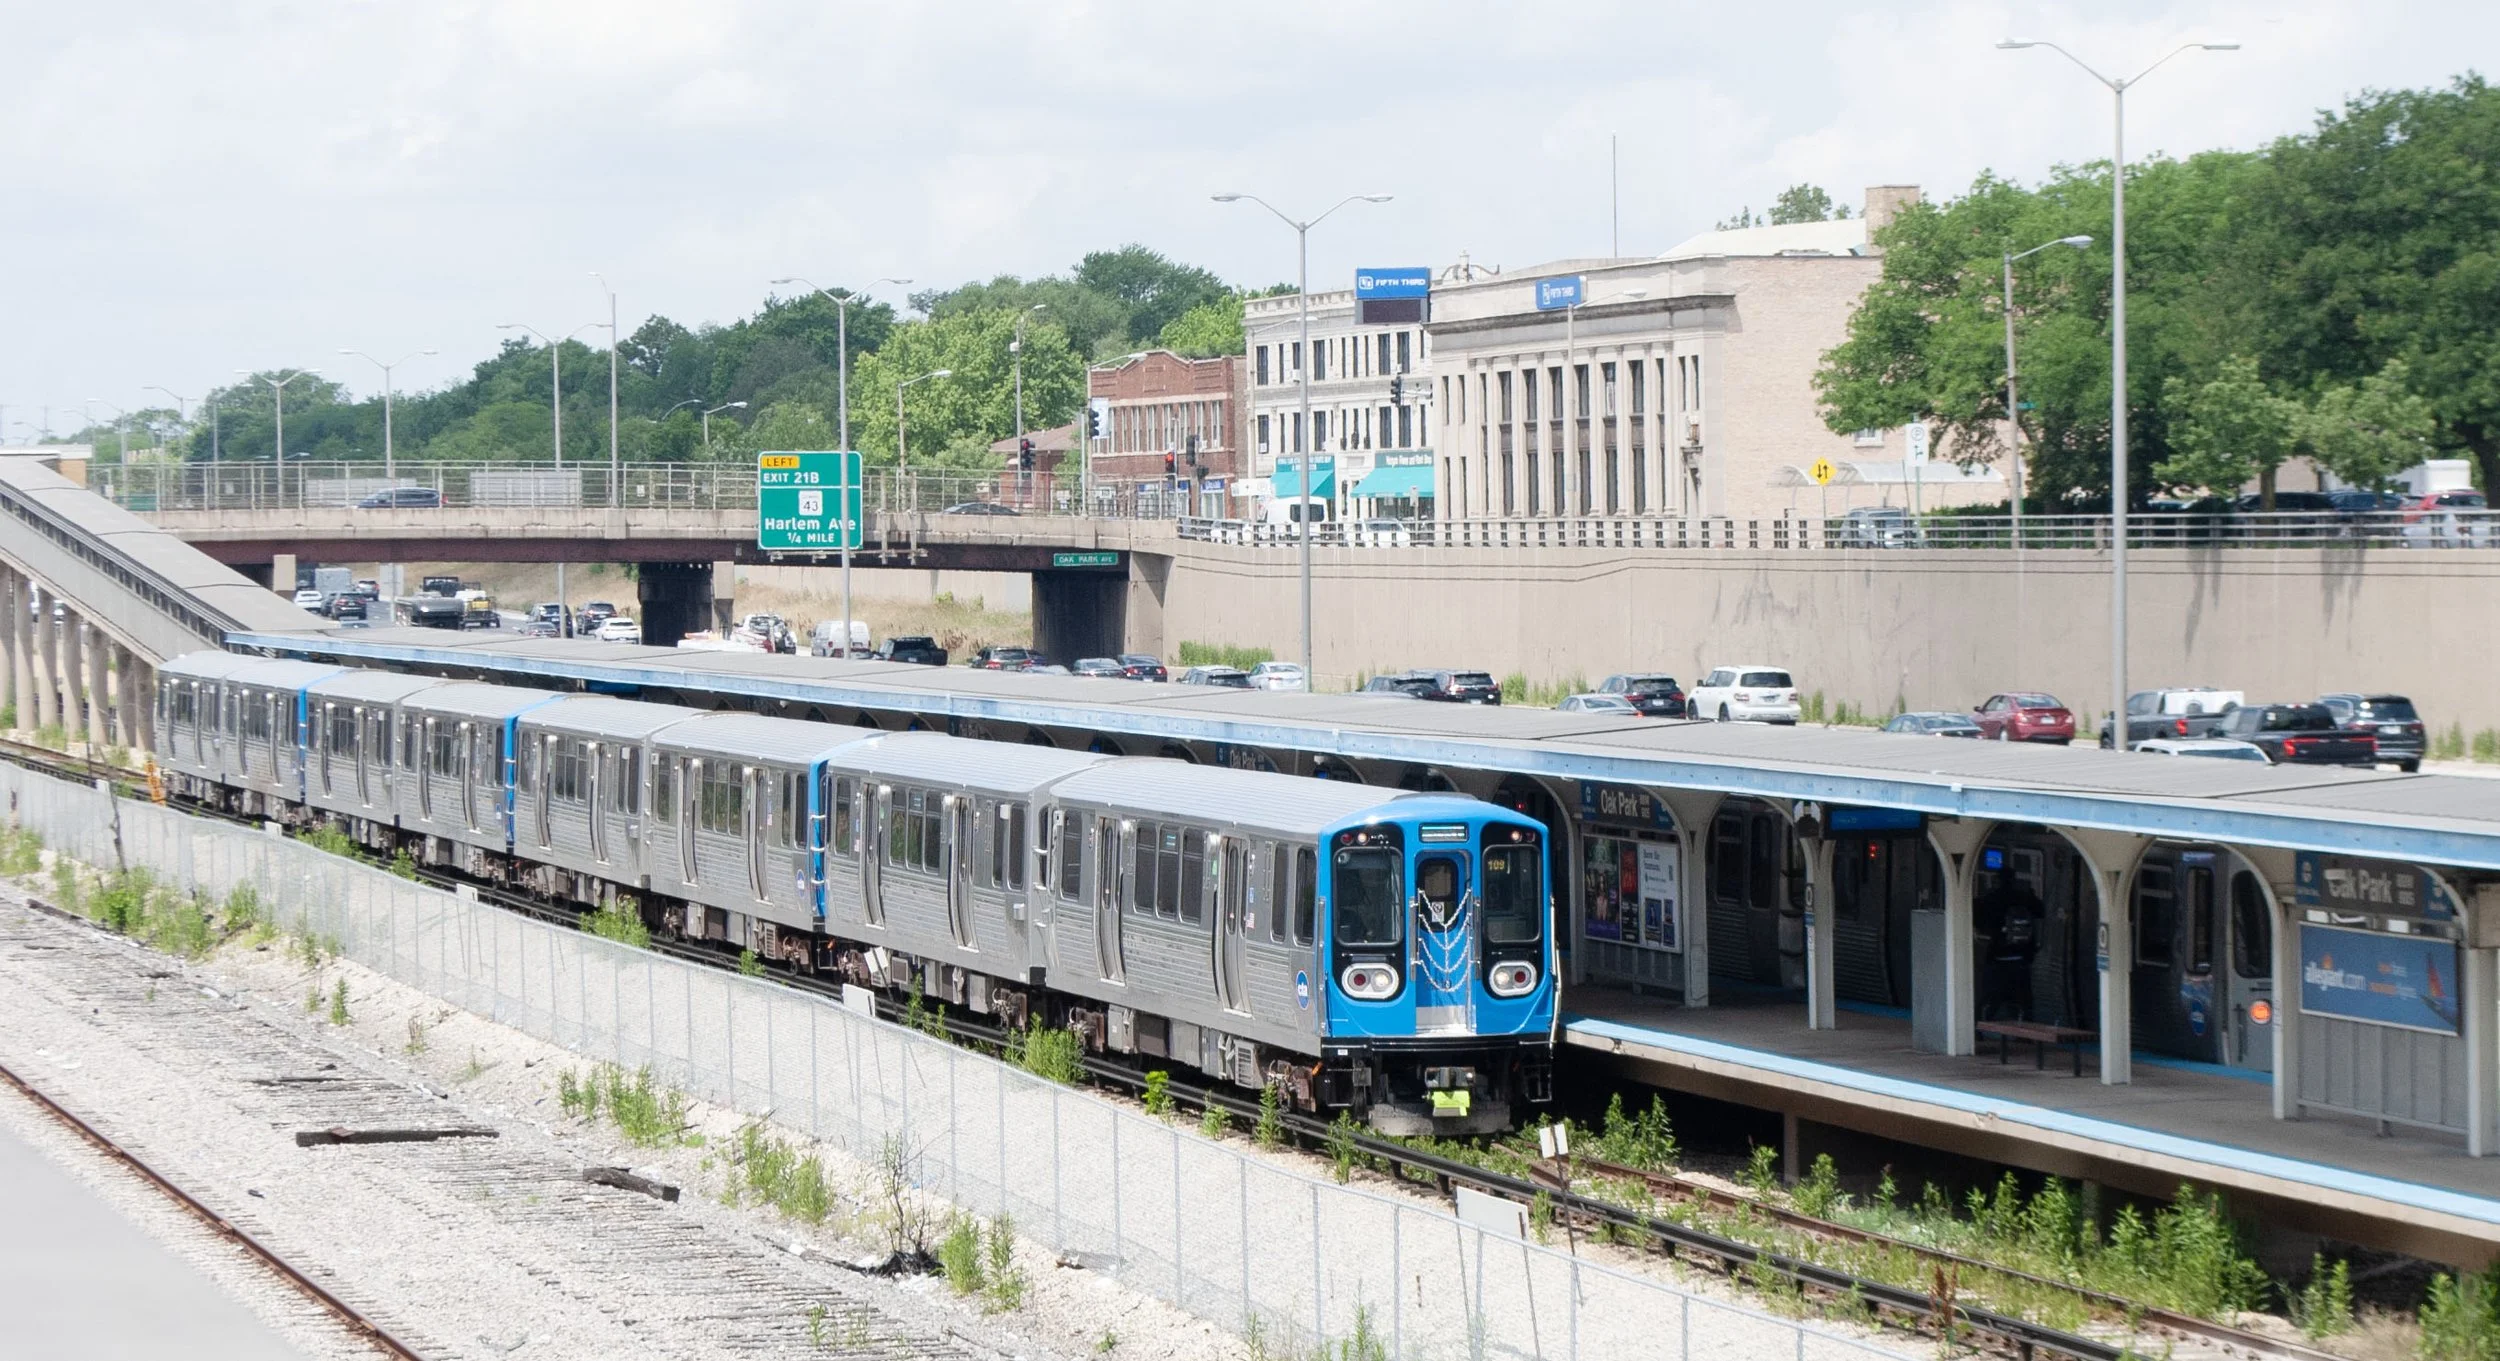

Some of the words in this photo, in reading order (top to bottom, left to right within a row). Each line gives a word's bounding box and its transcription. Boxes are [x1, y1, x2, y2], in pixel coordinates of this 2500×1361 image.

[1375, 278, 1399, 286] FIFTH
[1400, 278, 1426, 286] THIRD
[766, 457, 793, 466] LEFT
[763, 472, 789, 483] EXIT
[793, 471, 820, 484] 21B
[803, 500, 819, 512] 43
[764, 517, 820, 531] Harlem
[807, 533, 835, 543] MILE
[1078, 555, 1098, 563] PARK
[1600, 789, 1617, 815] Oak
[1618, 791, 1638, 817] Park
[2357, 869, 2393, 904] Park
